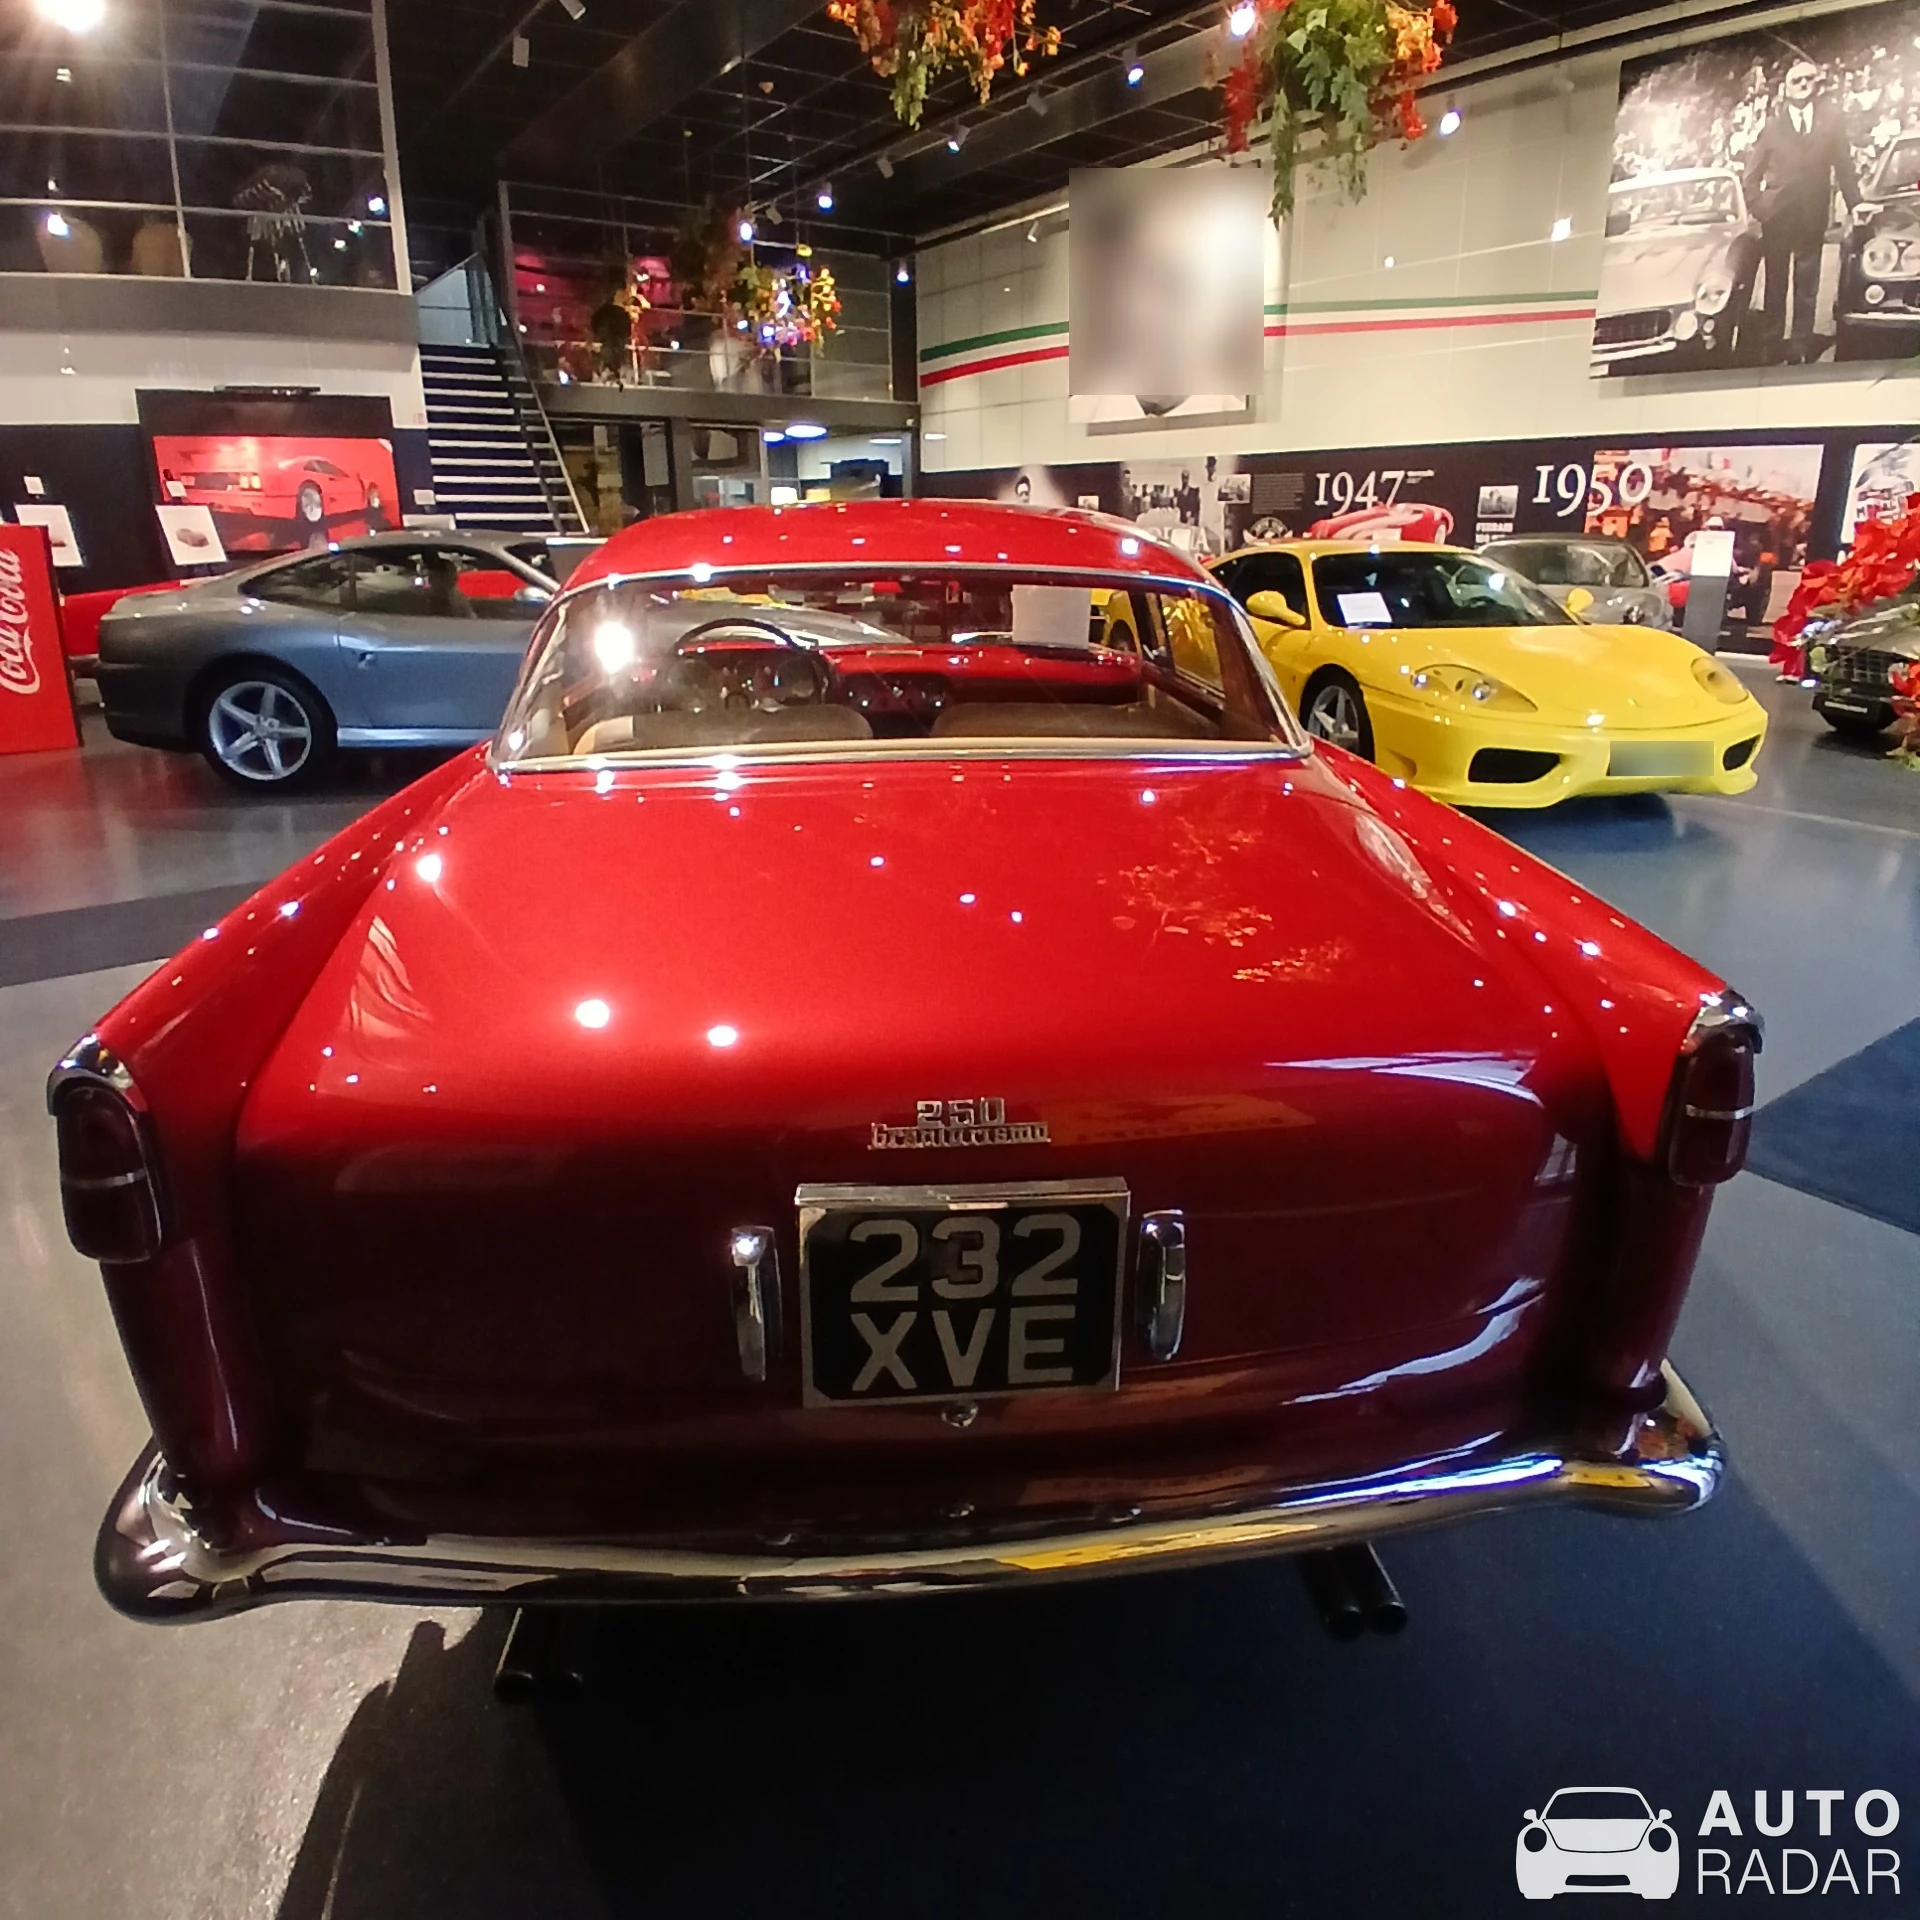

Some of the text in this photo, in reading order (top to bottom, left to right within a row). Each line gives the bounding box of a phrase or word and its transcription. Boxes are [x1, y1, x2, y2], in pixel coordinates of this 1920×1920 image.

[1314, 470, 1405, 517] 1947
[1532, 463, 1653, 517] 1950
[916, 1097, 1005, 1128] 250
[850, 1213, 1081, 1302] 232
[851, 1305, 1076, 1391] XVE
